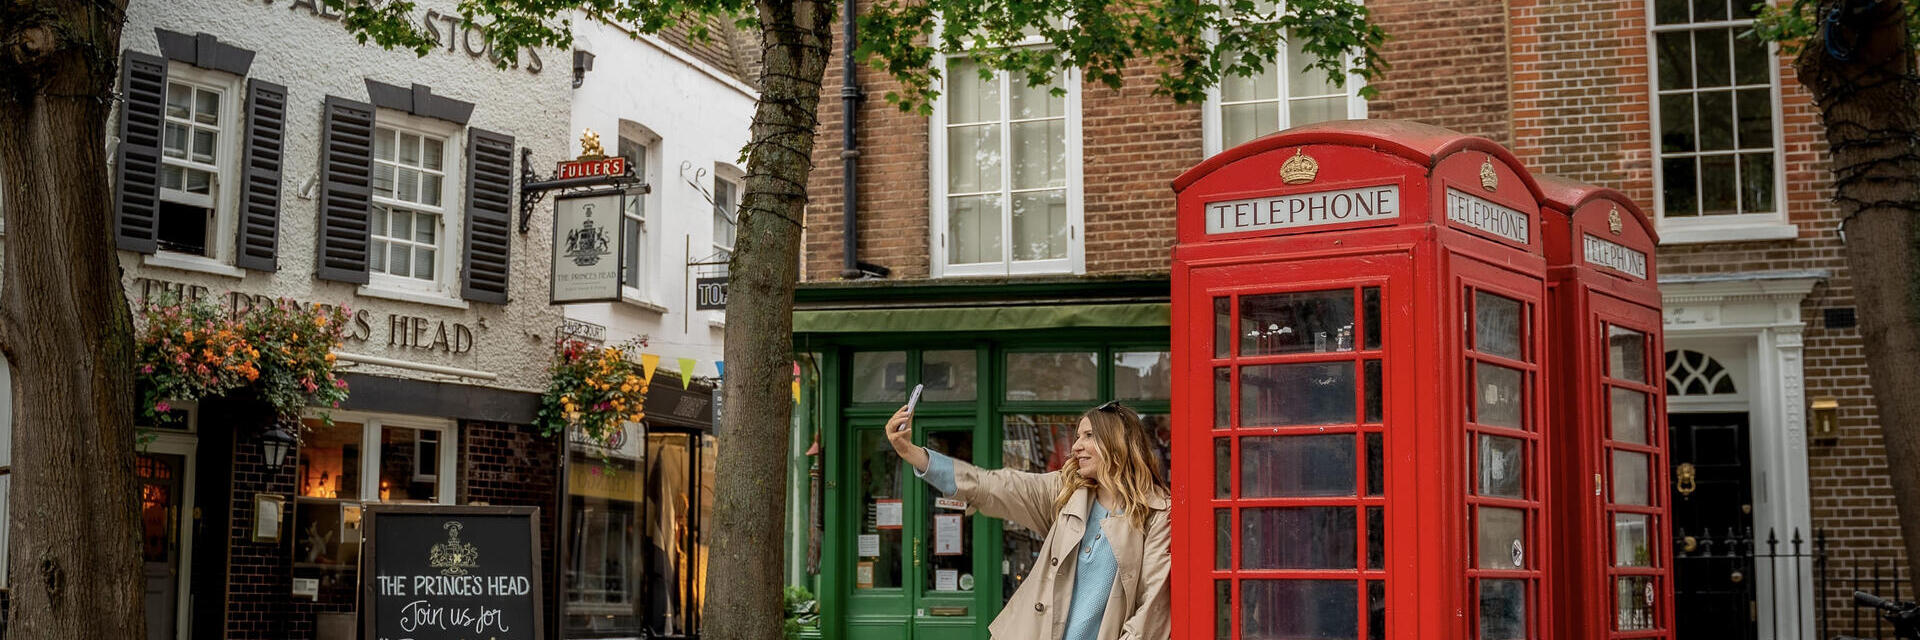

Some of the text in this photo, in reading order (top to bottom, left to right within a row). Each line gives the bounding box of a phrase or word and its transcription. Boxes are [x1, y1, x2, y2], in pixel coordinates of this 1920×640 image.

[560, 160, 620, 178] FULLER'S
[1213, 189, 1393, 229] TELEPHONE
[1448, 192, 1526, 242] TELEPHONE
[1584, 236, 1645, 277] TELEPHONE
[229, 290, 371, 342] PRNS
[388, 313, 473, 354] HEAD
[377, 575, 406, 596] THE
[488, 576, 530, 596] HEAD
[400, 600, 509, 634] Join us for
